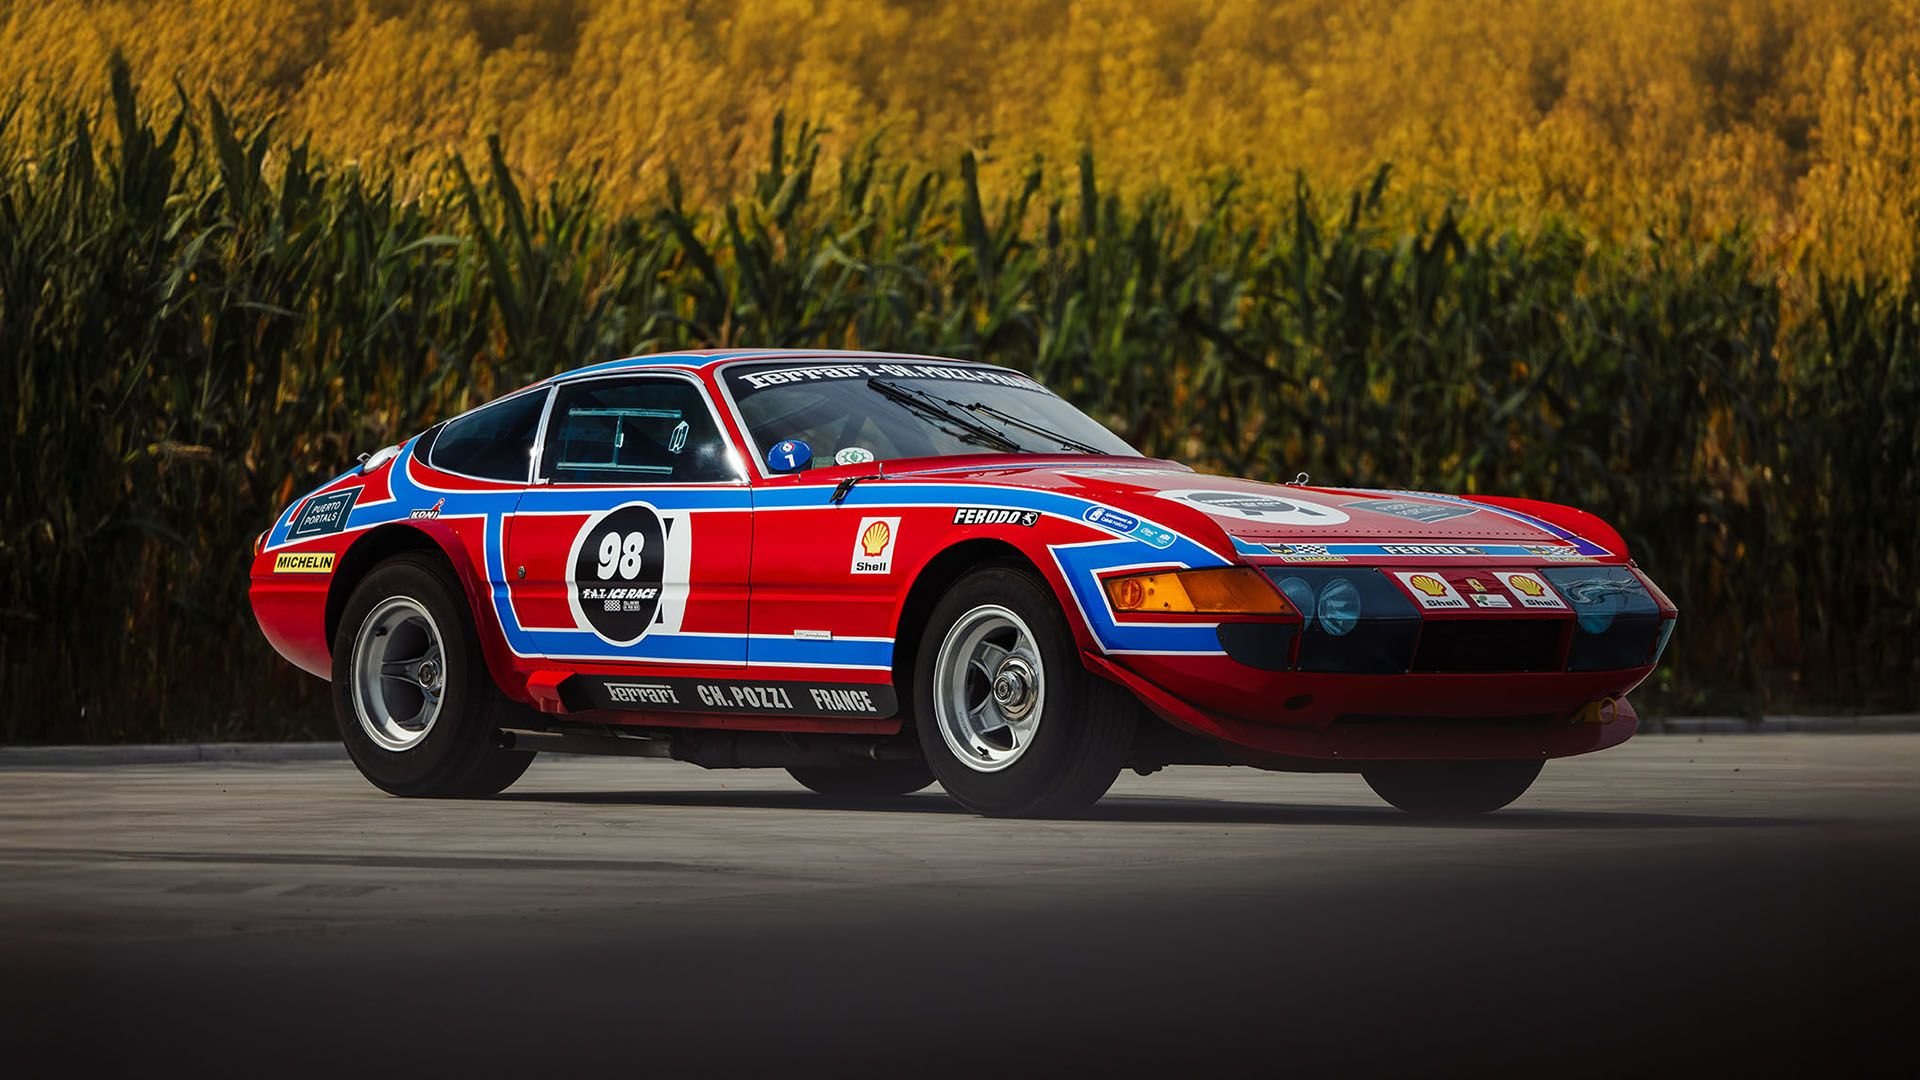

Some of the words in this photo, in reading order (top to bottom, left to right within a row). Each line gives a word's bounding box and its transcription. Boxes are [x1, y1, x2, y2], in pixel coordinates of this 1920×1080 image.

[784, 454, 796, 467] 1
[312, 501, 341, 514] PUERTO
[304, 512, 338, 525] PORTALS
[411, 511, 439, 520] KONI
[953, 509, 1022, 524] FERODO
[597, 532, 645, 580] 98
[1382, 546, 1467, 554] FERODO
[277, 554, 333, 569] MICHELIN
[856, 562, 886, 571] Shell
[607, 588, 628, 599] ICE
[626, 588, 657, 599] RACE
[1426, 599, 1462, 607] Shell
[1525, 599, 1561, 607] Shell
[603, 682, 680, 704] Ferrari
[809, 688, 877, 712] FRANCE
